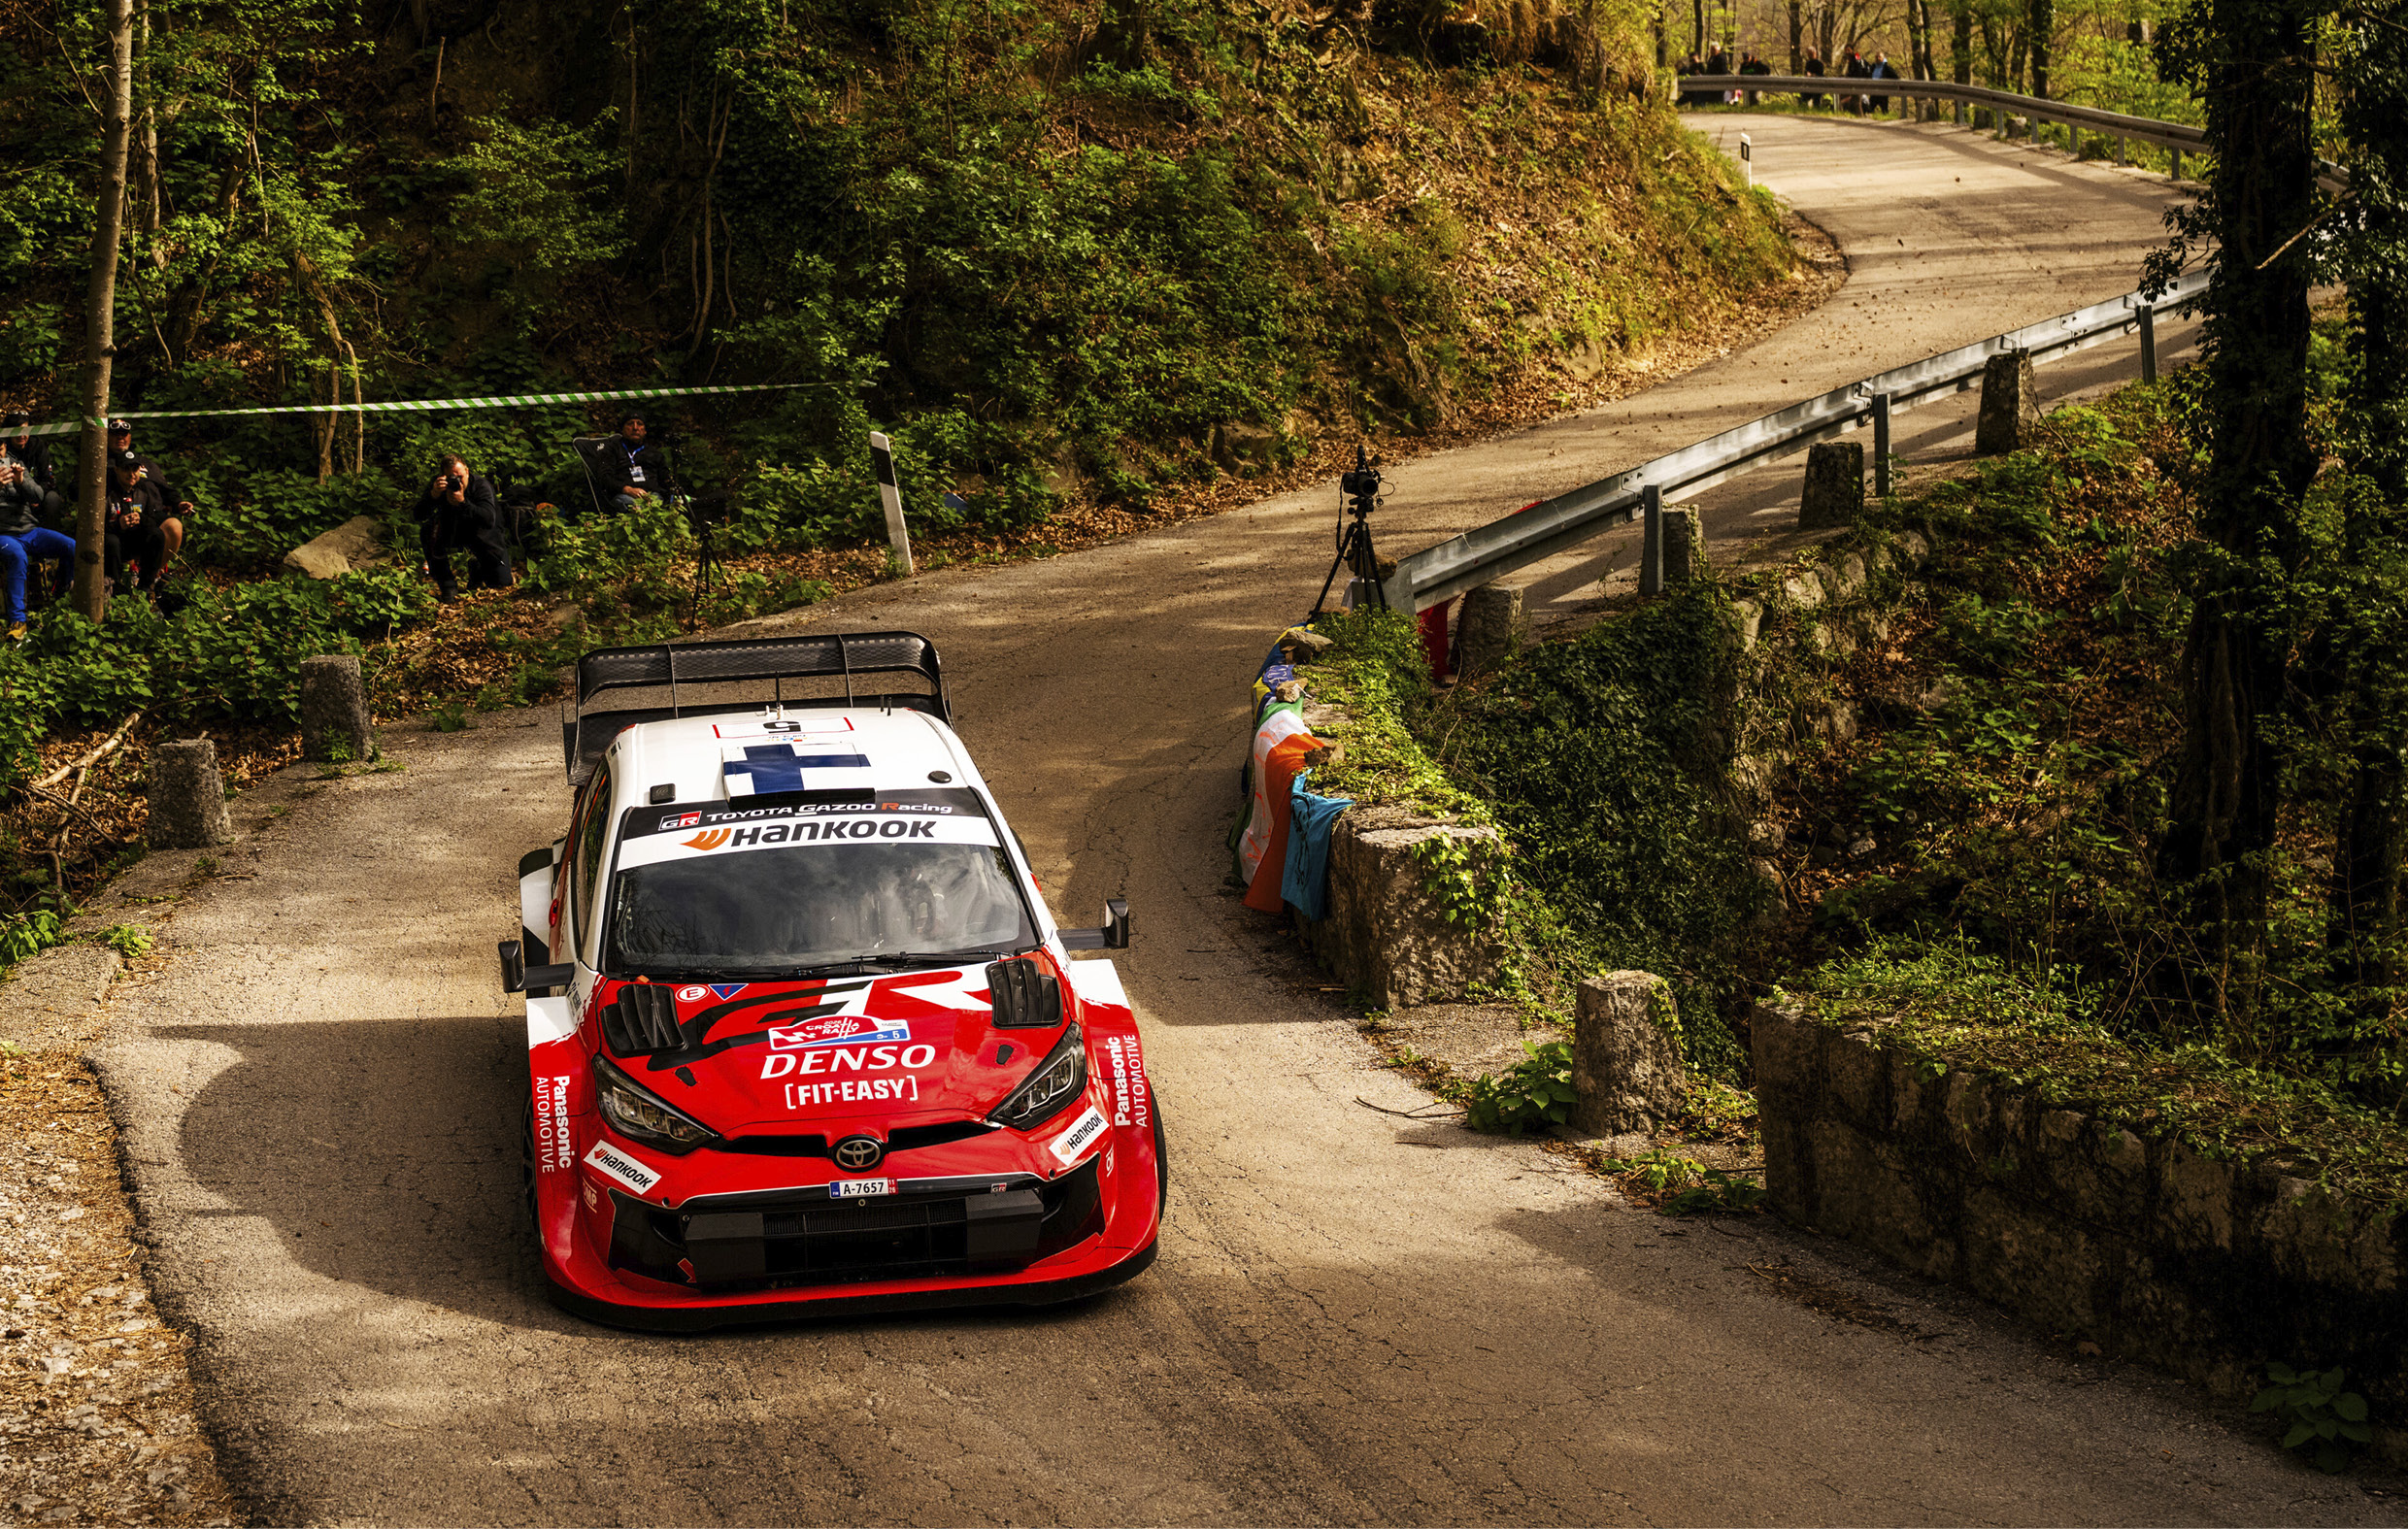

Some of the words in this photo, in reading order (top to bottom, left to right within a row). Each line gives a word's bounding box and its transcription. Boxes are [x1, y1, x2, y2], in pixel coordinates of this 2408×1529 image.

[662, 813, 699, 829] GR
[707, 807, 792, 822] TOYOTA
[797, 803, 877, 817] GAZOO
[881, 802, 953, 815] Racing
[686, 988, 699, 999] E
[892, 1030, 900, 1040] 5
[760, 1045, 936, 1080] DENSO
[785, 1076, 919, 1110] [FIT-EASY]
[1105, 1036, 1131, 1127] Panasonic
[1122, 1034, 1148, 1128] AUTOMOTIVE
[536, 1077, 554, 1174] AUTOMOTIVE
[553, 1076, 575, 1169] Panasonic
[843, 1181, 884, 1195] A-7657
